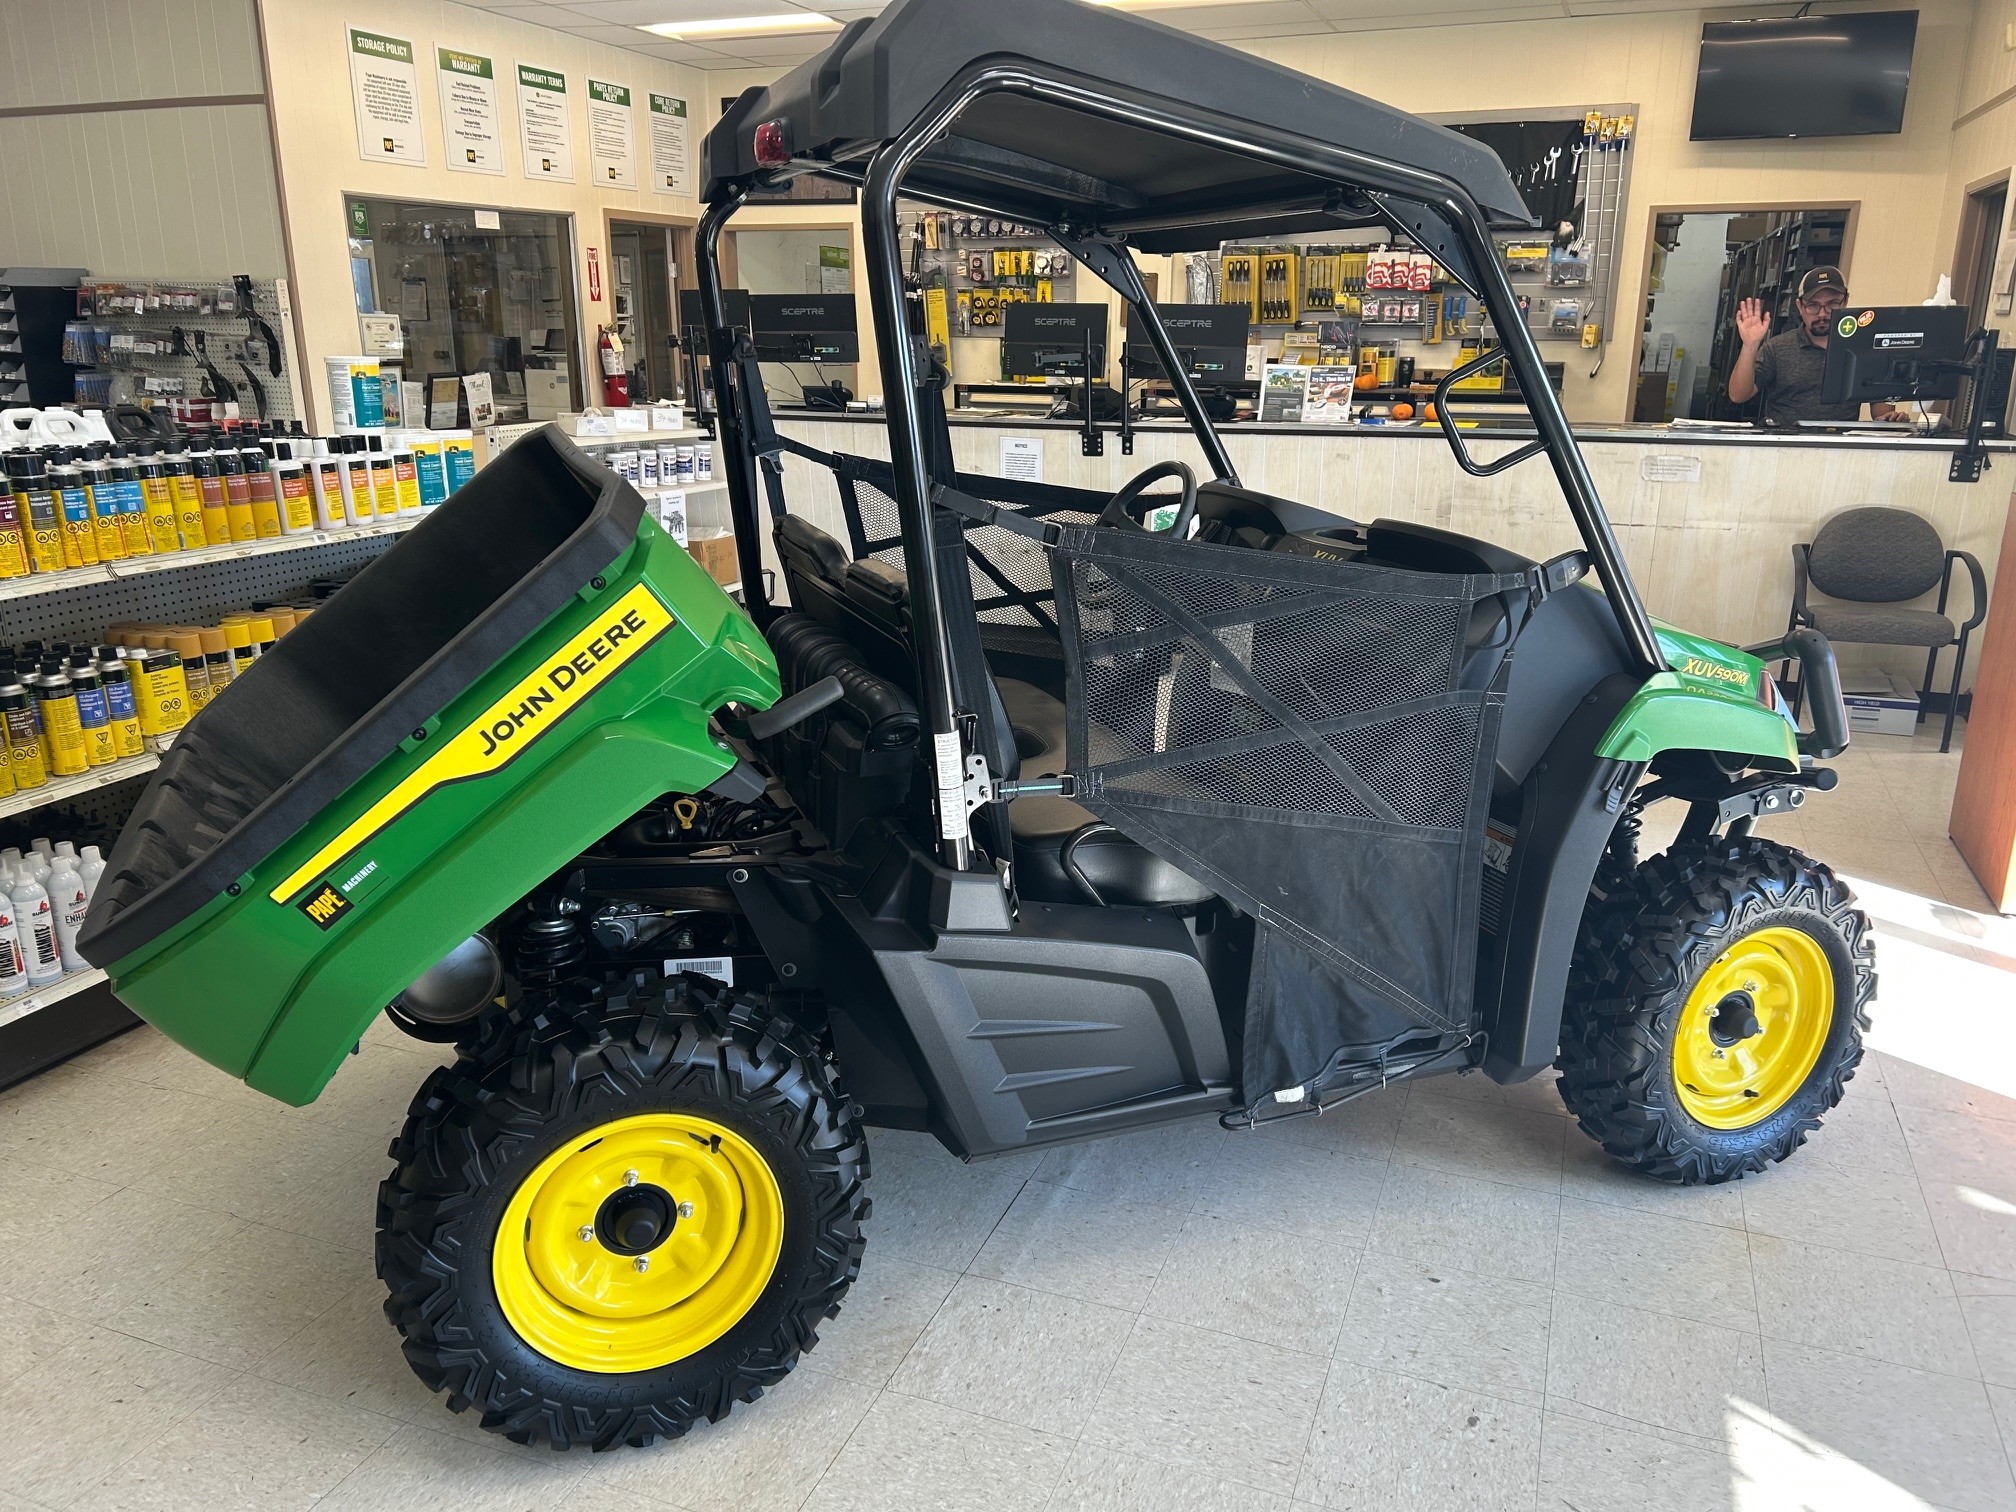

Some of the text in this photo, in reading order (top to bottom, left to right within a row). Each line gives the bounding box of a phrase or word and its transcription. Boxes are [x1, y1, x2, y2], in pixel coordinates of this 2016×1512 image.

[356, 36, 407, 56] STORAGE POLICY
[452, 60, 480, 73] WARRANTY
[522, 72, 563, 88] WARRANTY TERMS
[594, 82, 624, 97] PARTS RETURN
[603, 93, 618, 102] POLICY
[654, 96, 680, 108] CORE RETURN
[662, 105, 676, 114] POLICY
[1034, 318, 1076, 326] SCEPTRE
[1162, 319, 1212, 328] SCEPTRE
[1682, 658, 1750, 686] XUV590M
[479, 608, 646, 756] JOHN DEERE
[342, 860, 378, 892] MACHINERY
